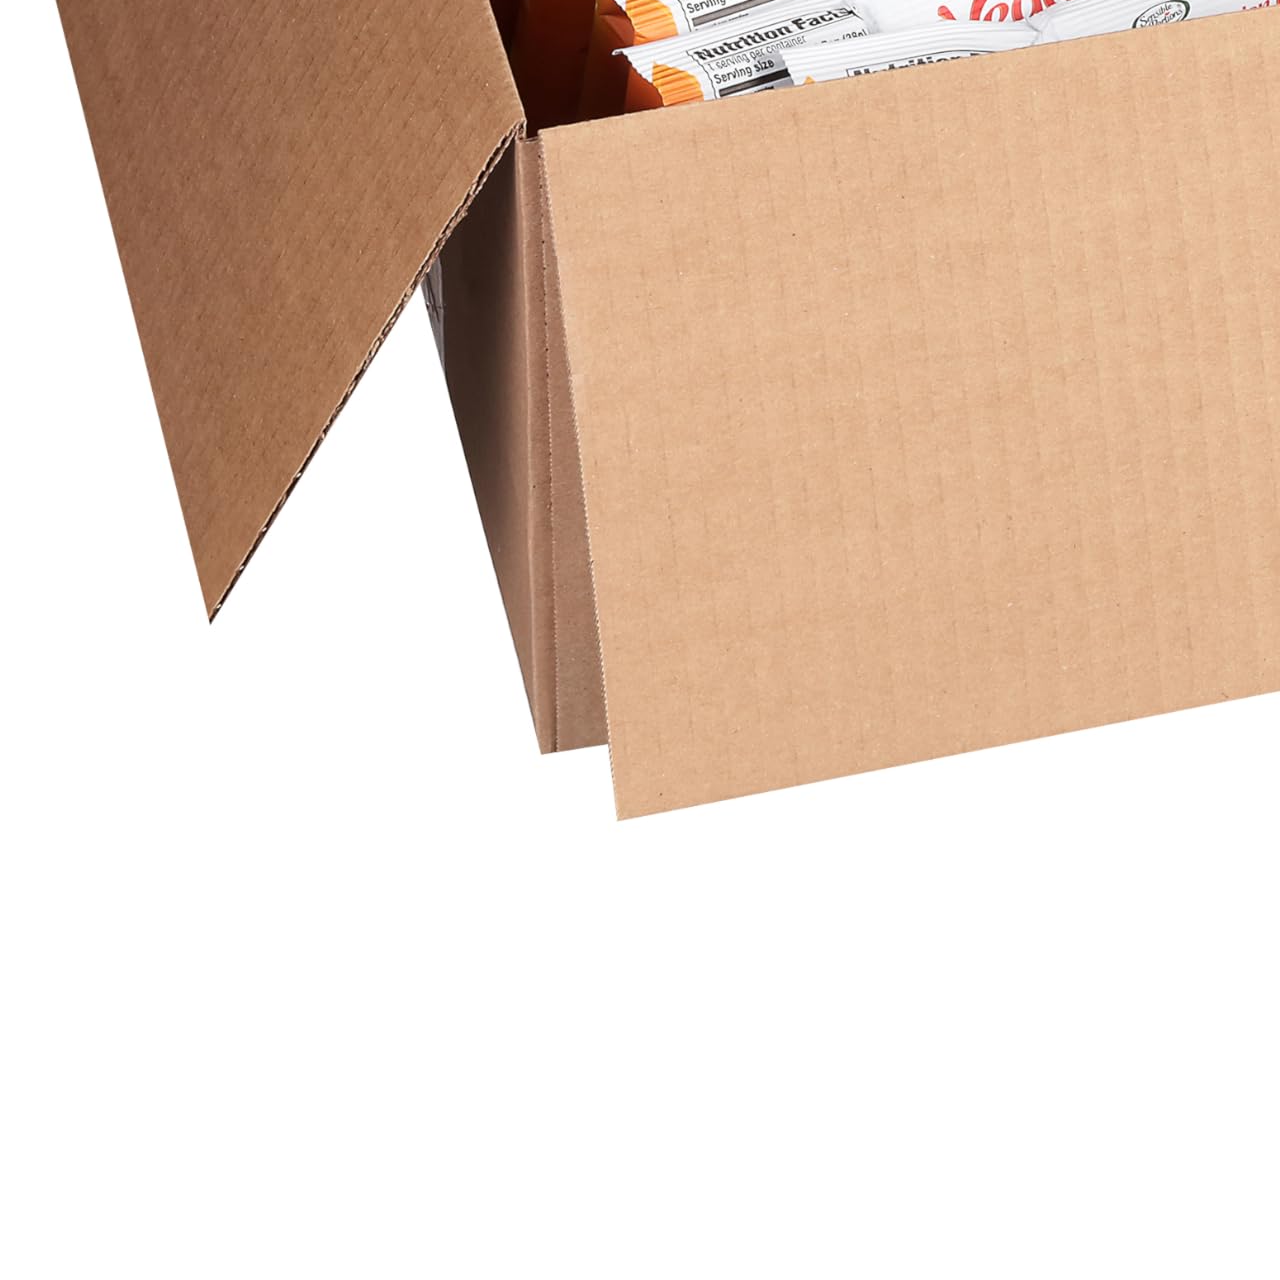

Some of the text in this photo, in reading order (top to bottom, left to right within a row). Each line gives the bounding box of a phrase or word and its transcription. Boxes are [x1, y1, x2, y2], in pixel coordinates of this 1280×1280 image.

[694, 26, 792, 61] Nutrition
[713, 58, 776, 85] Serving size
[716, 52, 750, 69] serving
[749, 47, 766, 63] per
